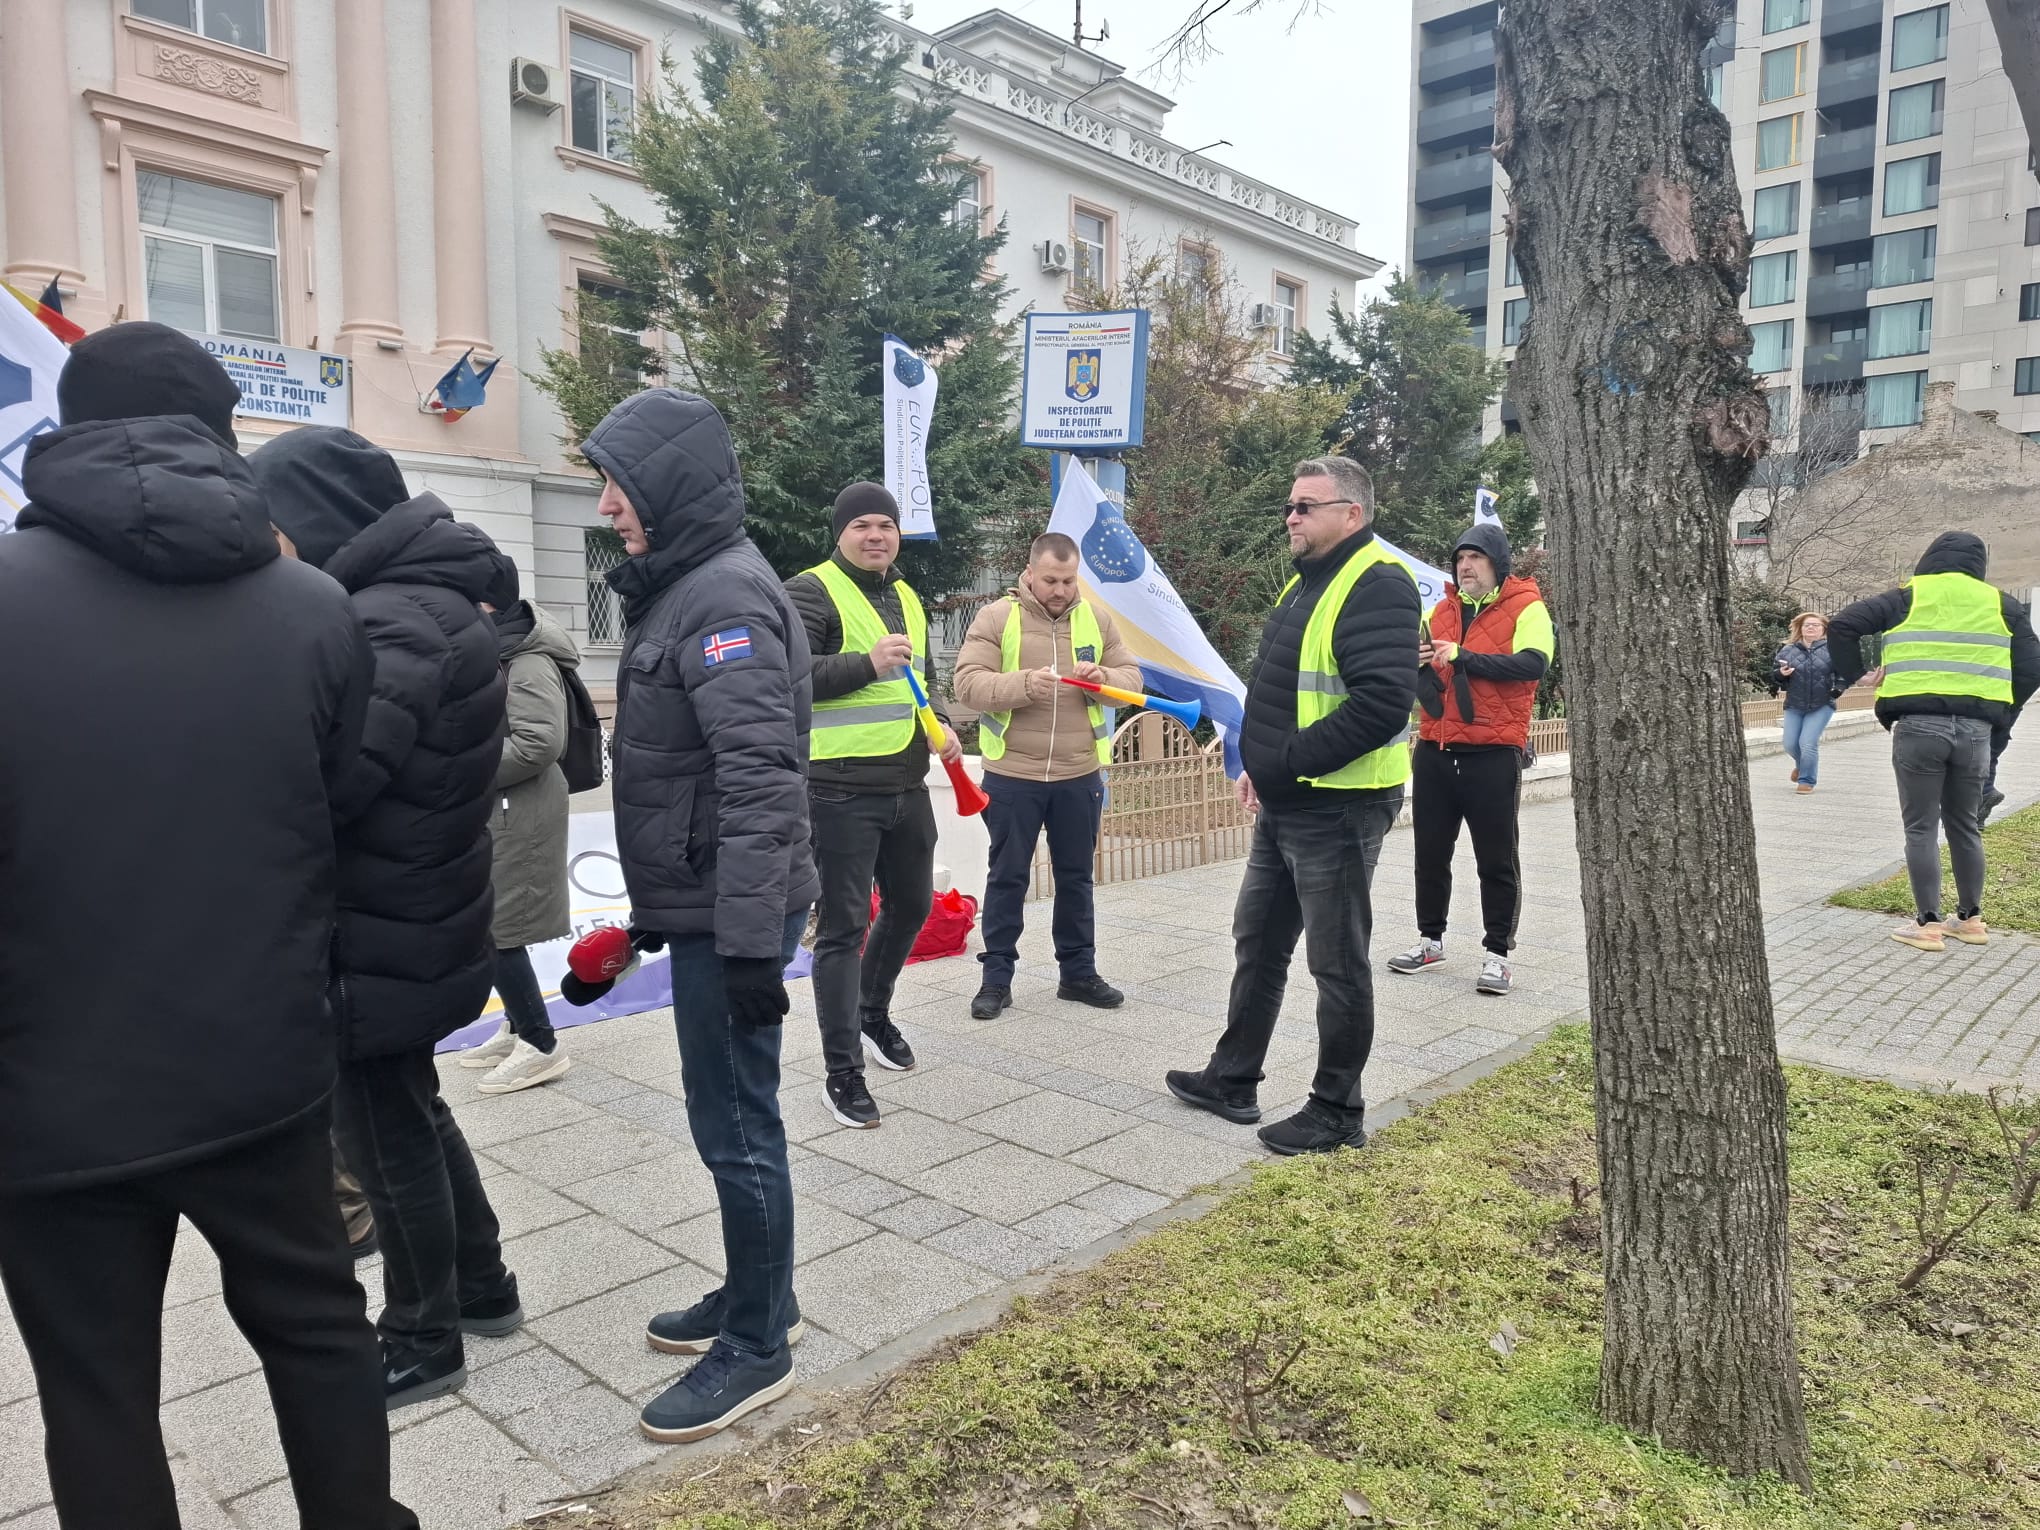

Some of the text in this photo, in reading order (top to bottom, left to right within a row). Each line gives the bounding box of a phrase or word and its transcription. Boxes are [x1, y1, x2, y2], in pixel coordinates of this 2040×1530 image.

[227, 370, 246, 378] NERAL
[228, 361, 262, 372] AFACERILOR
[264, 367, 287, 376] INTERNE
[260, 382, 276, 397] DE
[282, 386, 327, 405] POLIȚIE
[1048, 406, 1112, 416] INSPECTORATUL
[1060, 418, 1102, 428] DE POLIȚIE
[1034, 428, 1122, 440] JUDEȚEAN CONSTANȚA
[1090, 554, 1128, 576] EUROPOL
